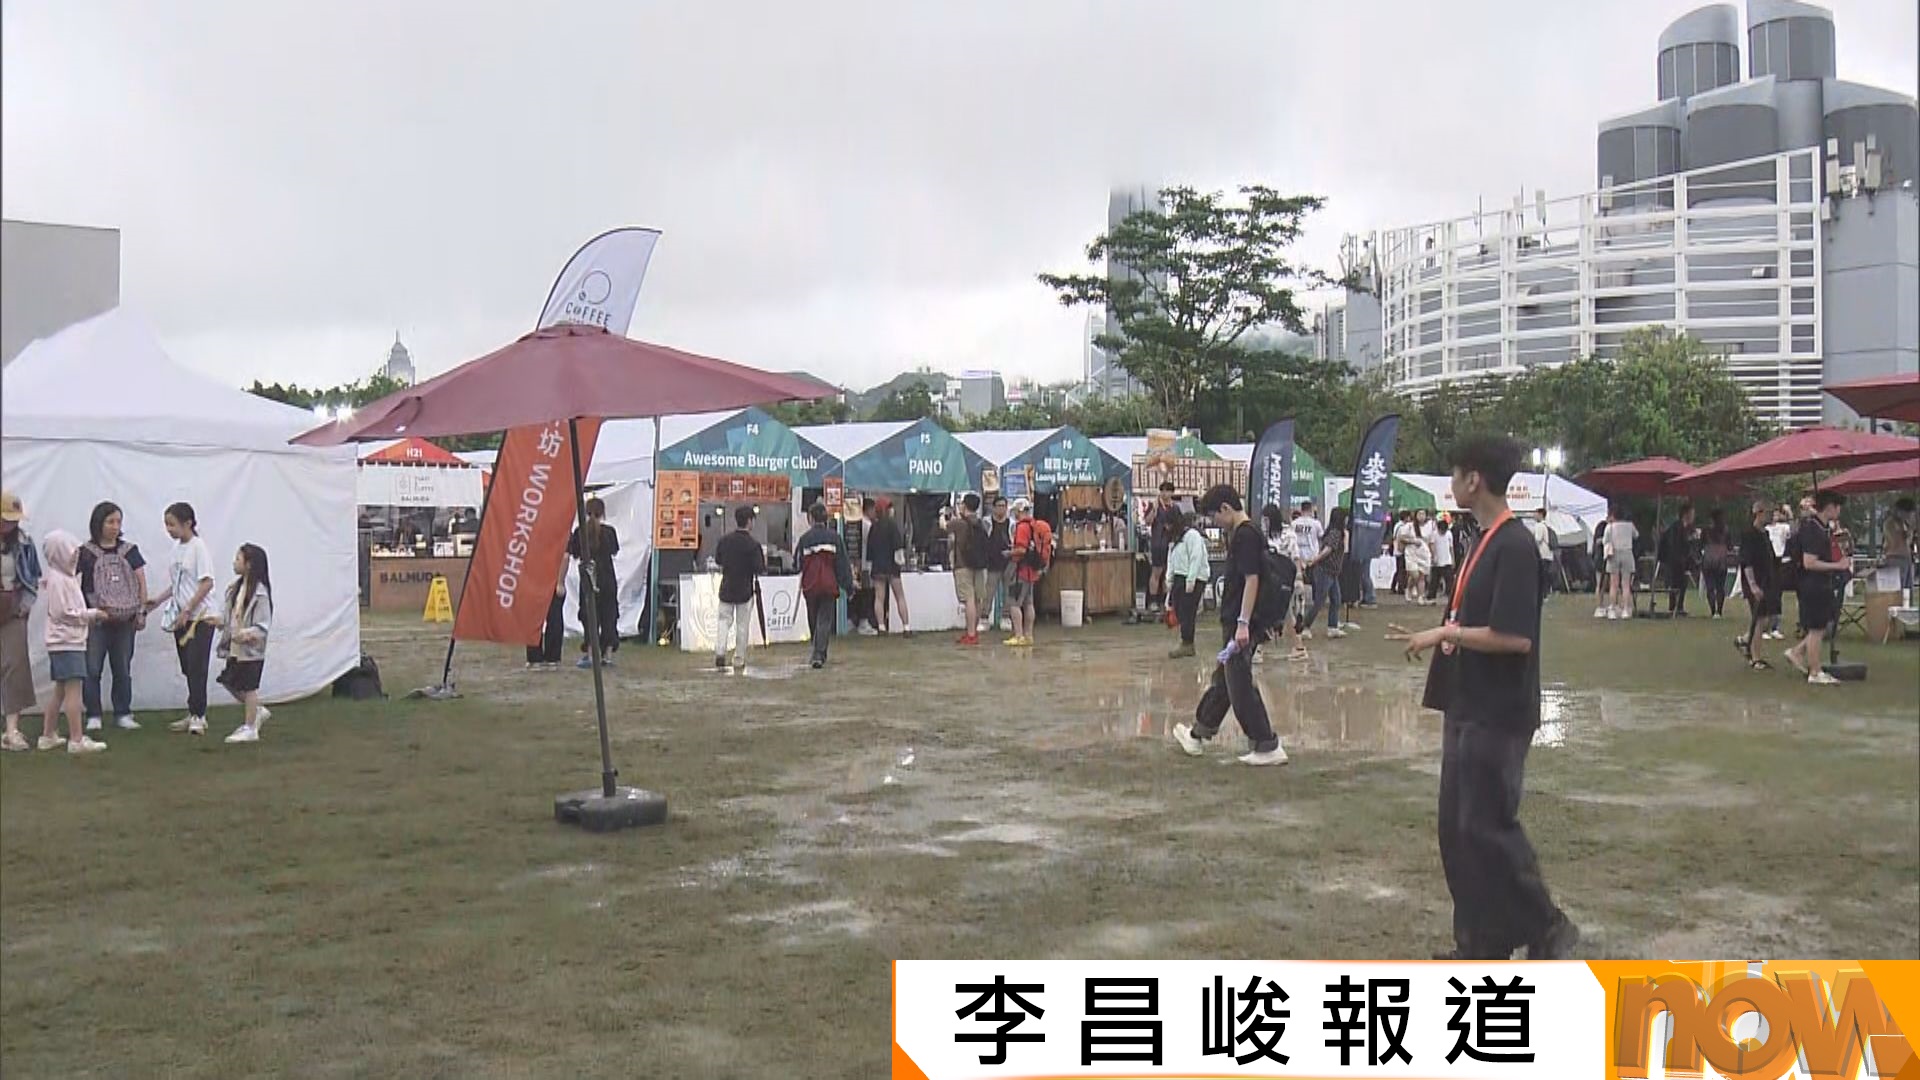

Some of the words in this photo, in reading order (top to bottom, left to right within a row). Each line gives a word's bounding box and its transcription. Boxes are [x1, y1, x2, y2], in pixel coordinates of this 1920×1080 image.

[565, 302, 612, 326] COFFEE
[746, 424, 759, 435] F4
[920, 433, 931, 444] F5
[406, 447, 423, 459] H21
[683, 450, 745, 466] Awesome
[747, 453, 789, 471] Burger
[791, 454, 818, 469] Club
[908, 458, 943, 475] PANO
[495, 463, 553, 610] WORKSHOP
